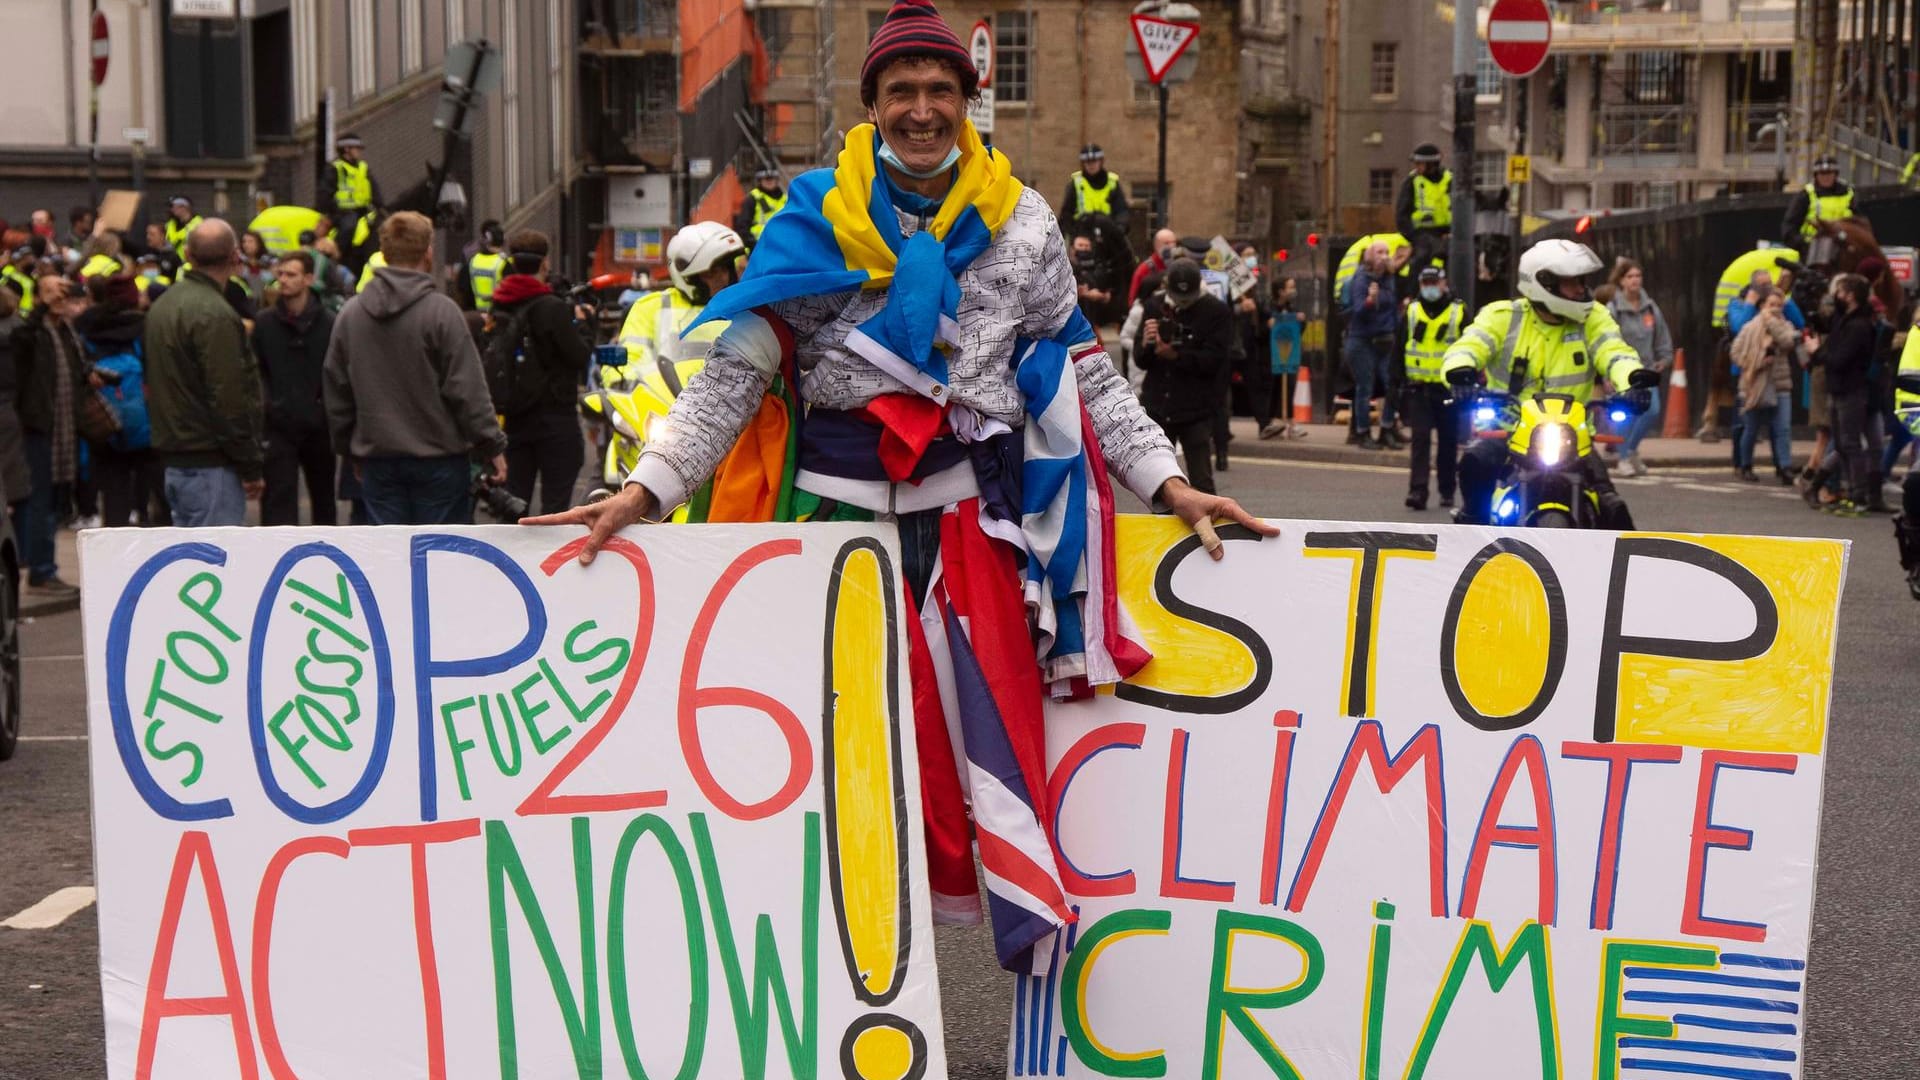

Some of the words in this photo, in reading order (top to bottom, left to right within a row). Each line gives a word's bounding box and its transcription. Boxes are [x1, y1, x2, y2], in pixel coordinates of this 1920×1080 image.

[1143, 23, 1182, 41] GIVE
[1149, 42, 1172, 53] WAY
[106, 533, 813, 824] COP26
[144, 571, 242, 788] STOP
[441, 619, 630, 800] FUELS
[1115, 523, 1778, 742] STOP
